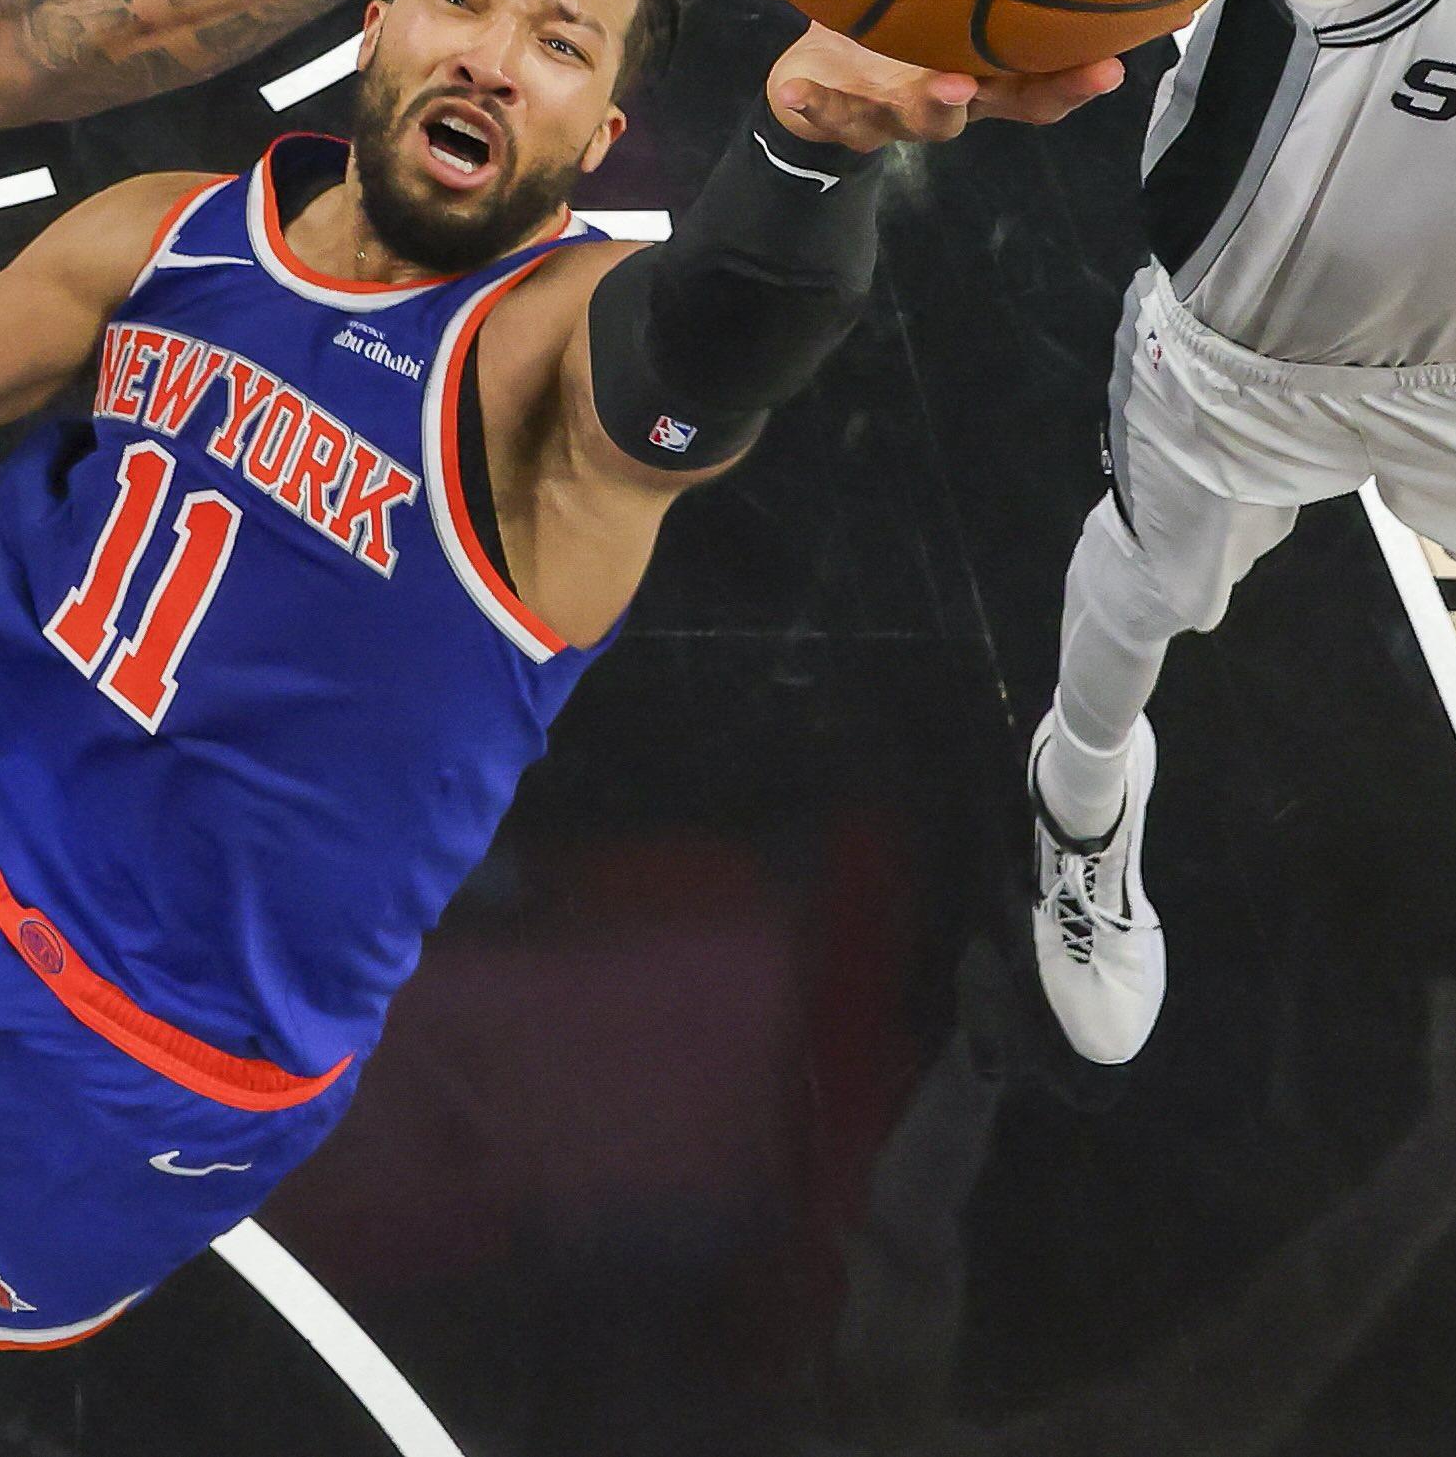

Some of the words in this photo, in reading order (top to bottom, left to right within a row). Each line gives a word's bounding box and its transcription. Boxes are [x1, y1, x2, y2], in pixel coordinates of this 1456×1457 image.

[93, 322, 229, 439] NEW
[205, 355, 423, 580] YORK
[364, 341, 425, 381] dhabi
[43, 439, 243, 735] 11
